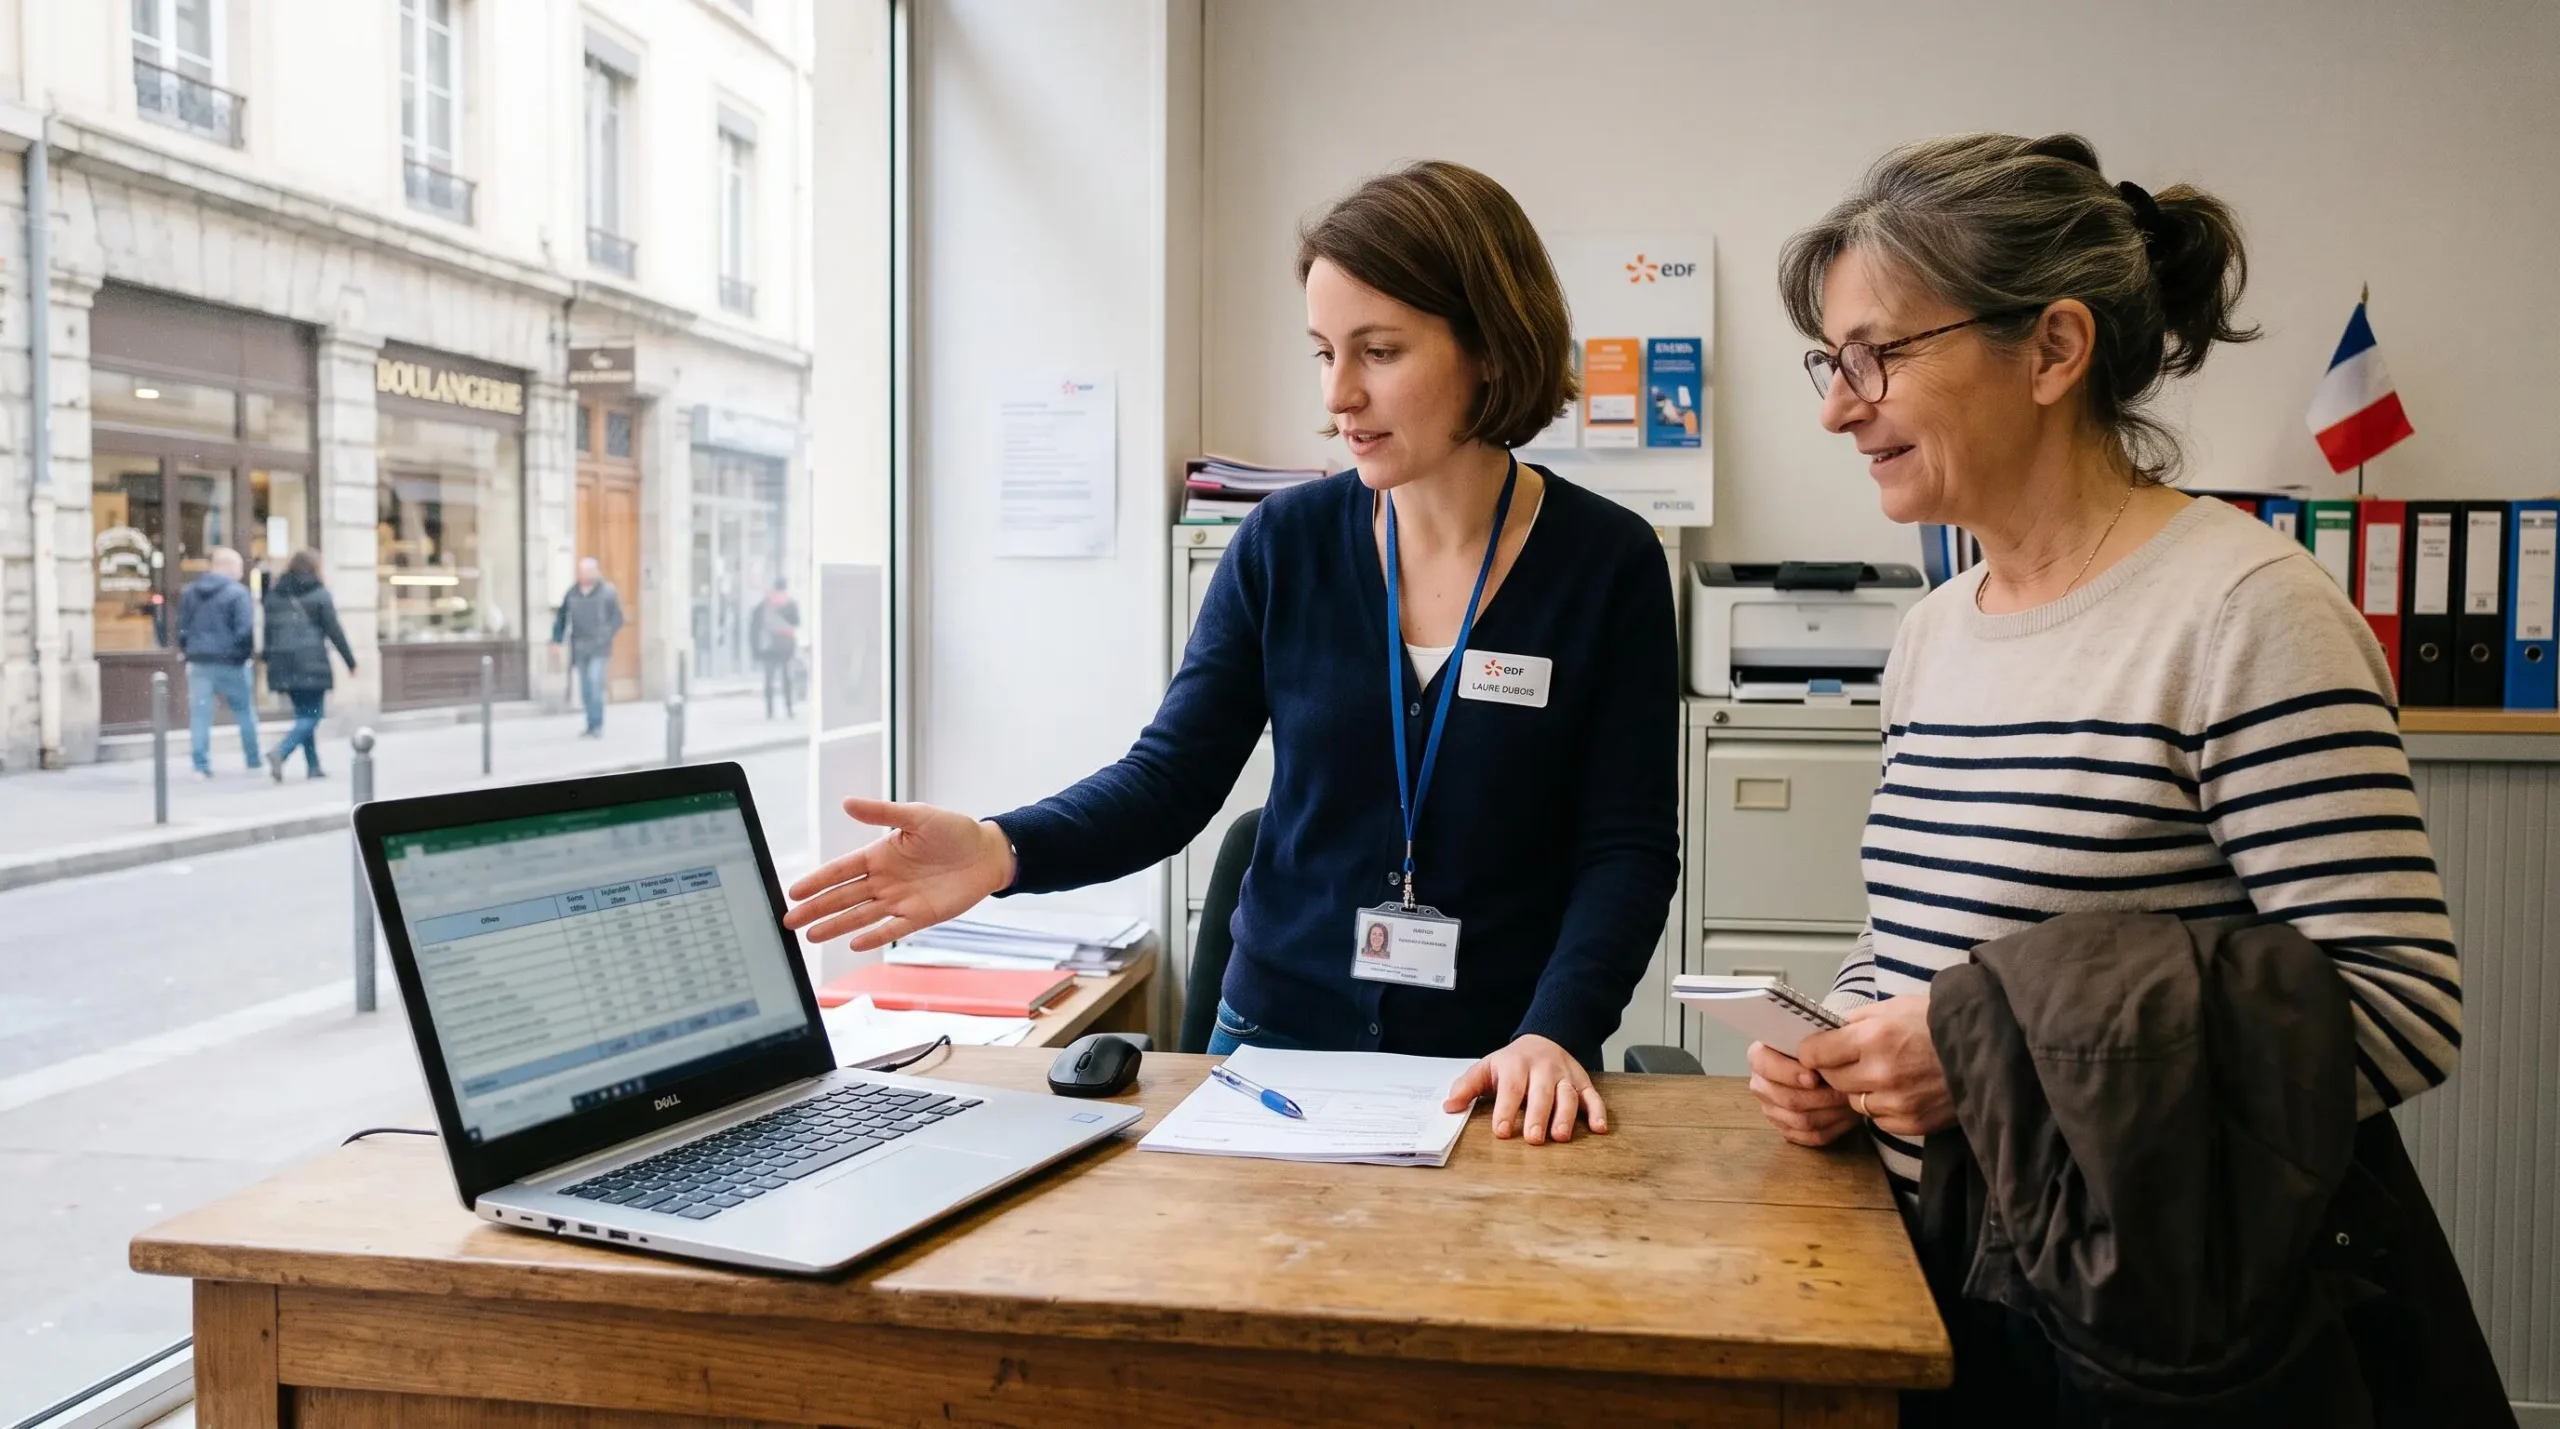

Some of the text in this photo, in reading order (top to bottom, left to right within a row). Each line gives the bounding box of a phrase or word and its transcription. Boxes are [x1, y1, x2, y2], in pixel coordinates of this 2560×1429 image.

[376, 358, 523, 415] BOULANGERIE
[1472, 682, 1535, 697] LAURE DUBOIS
[654, 1093, 682, 1111] DELL
